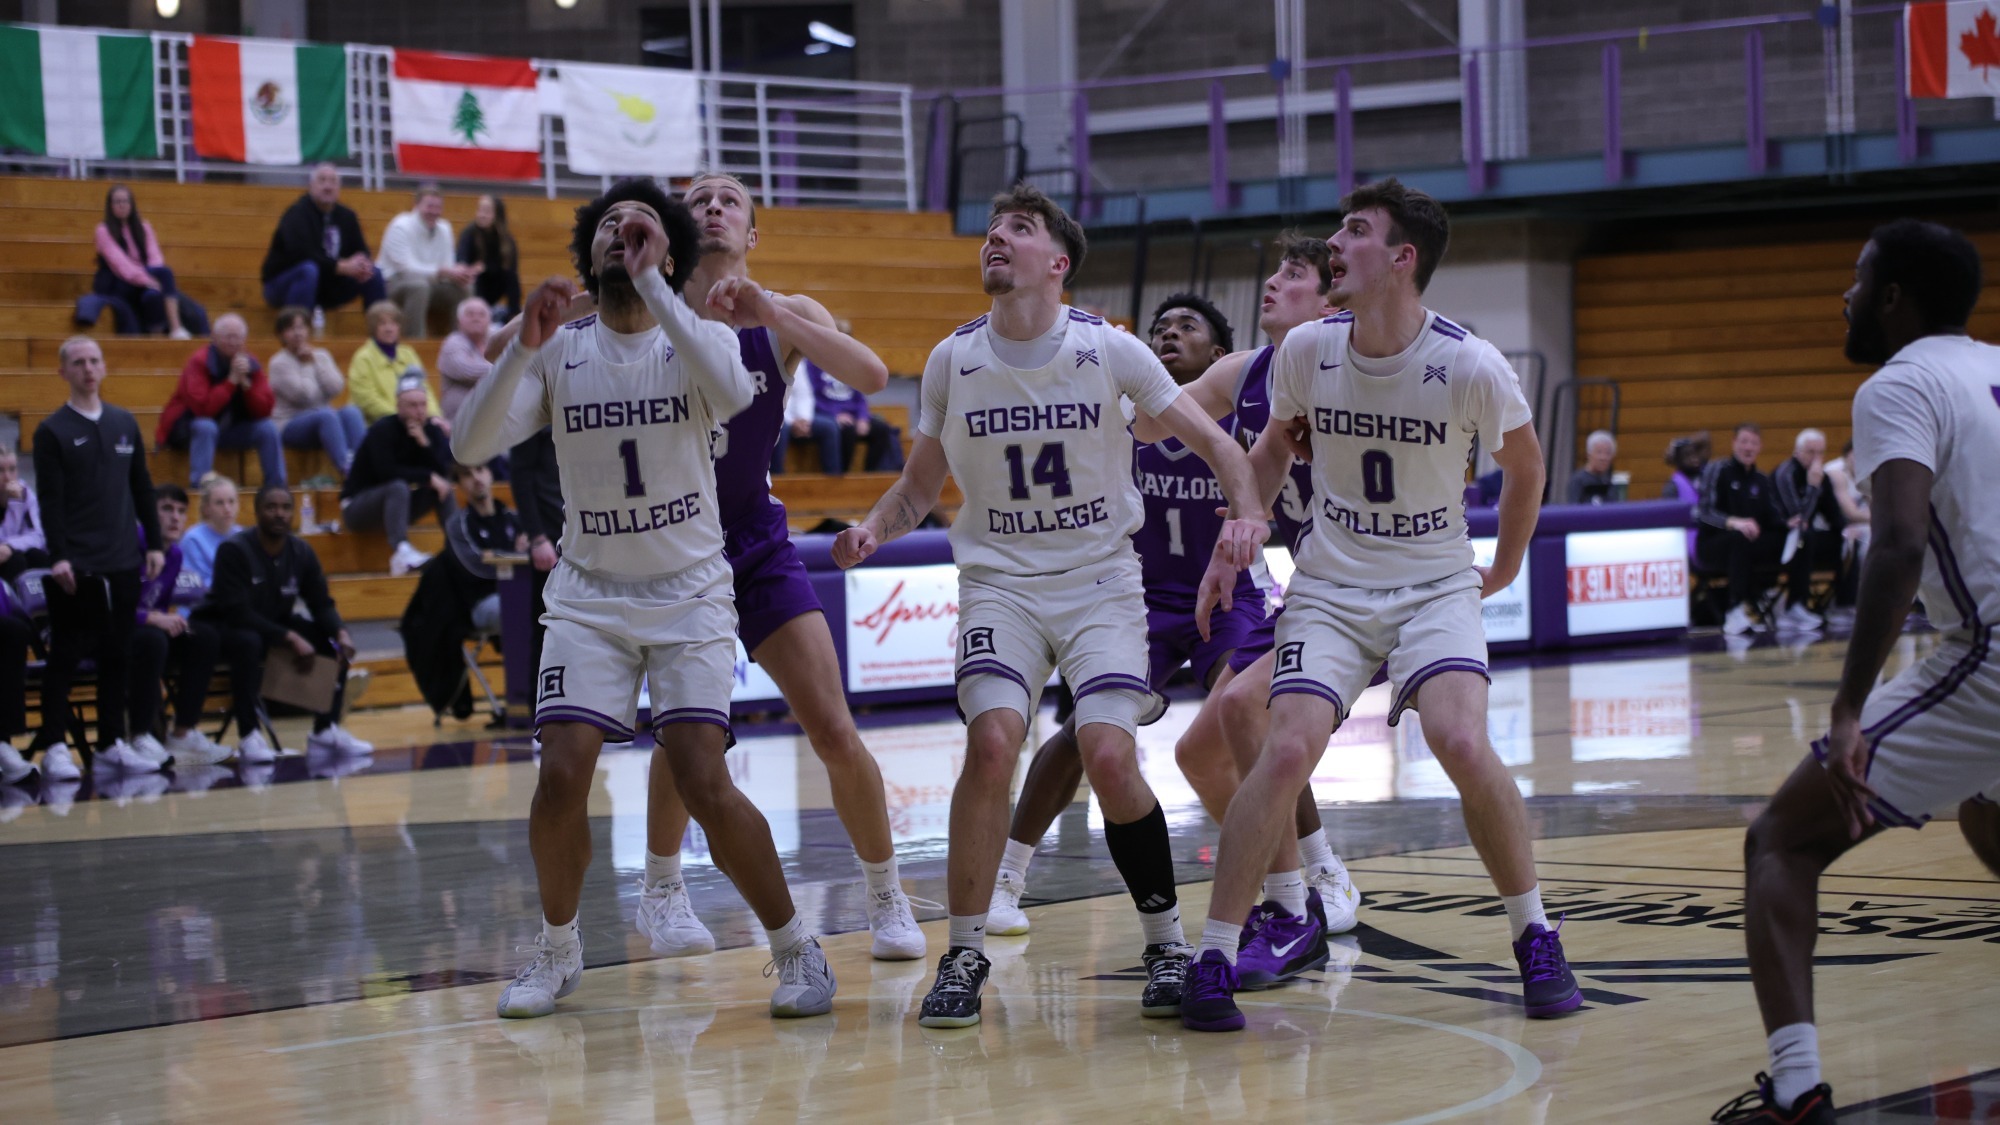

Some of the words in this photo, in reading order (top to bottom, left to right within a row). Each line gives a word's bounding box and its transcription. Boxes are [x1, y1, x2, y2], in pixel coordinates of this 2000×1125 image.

[563, 394, 690, 433] GOSHEN
[965, 403, 1101, 437] GOSHEN
[1314, 407, 1447, 445] GOSHEN
[619, 438, 646, 499] 1
[1004, 440, 1074, 501] 14
[1140, 472, 1223, 500] AYLOR
[1360, 449, 1396, 504] 0
[579, 492, 701, 536] COLLEGE
[988, 496, 1108, 534] COLLEGE
[1165, 508, 1185, 557] 1
[1323, 498, 1448, 538] COLLEGE
[1624, 563, 1684, 600] GLOBE
